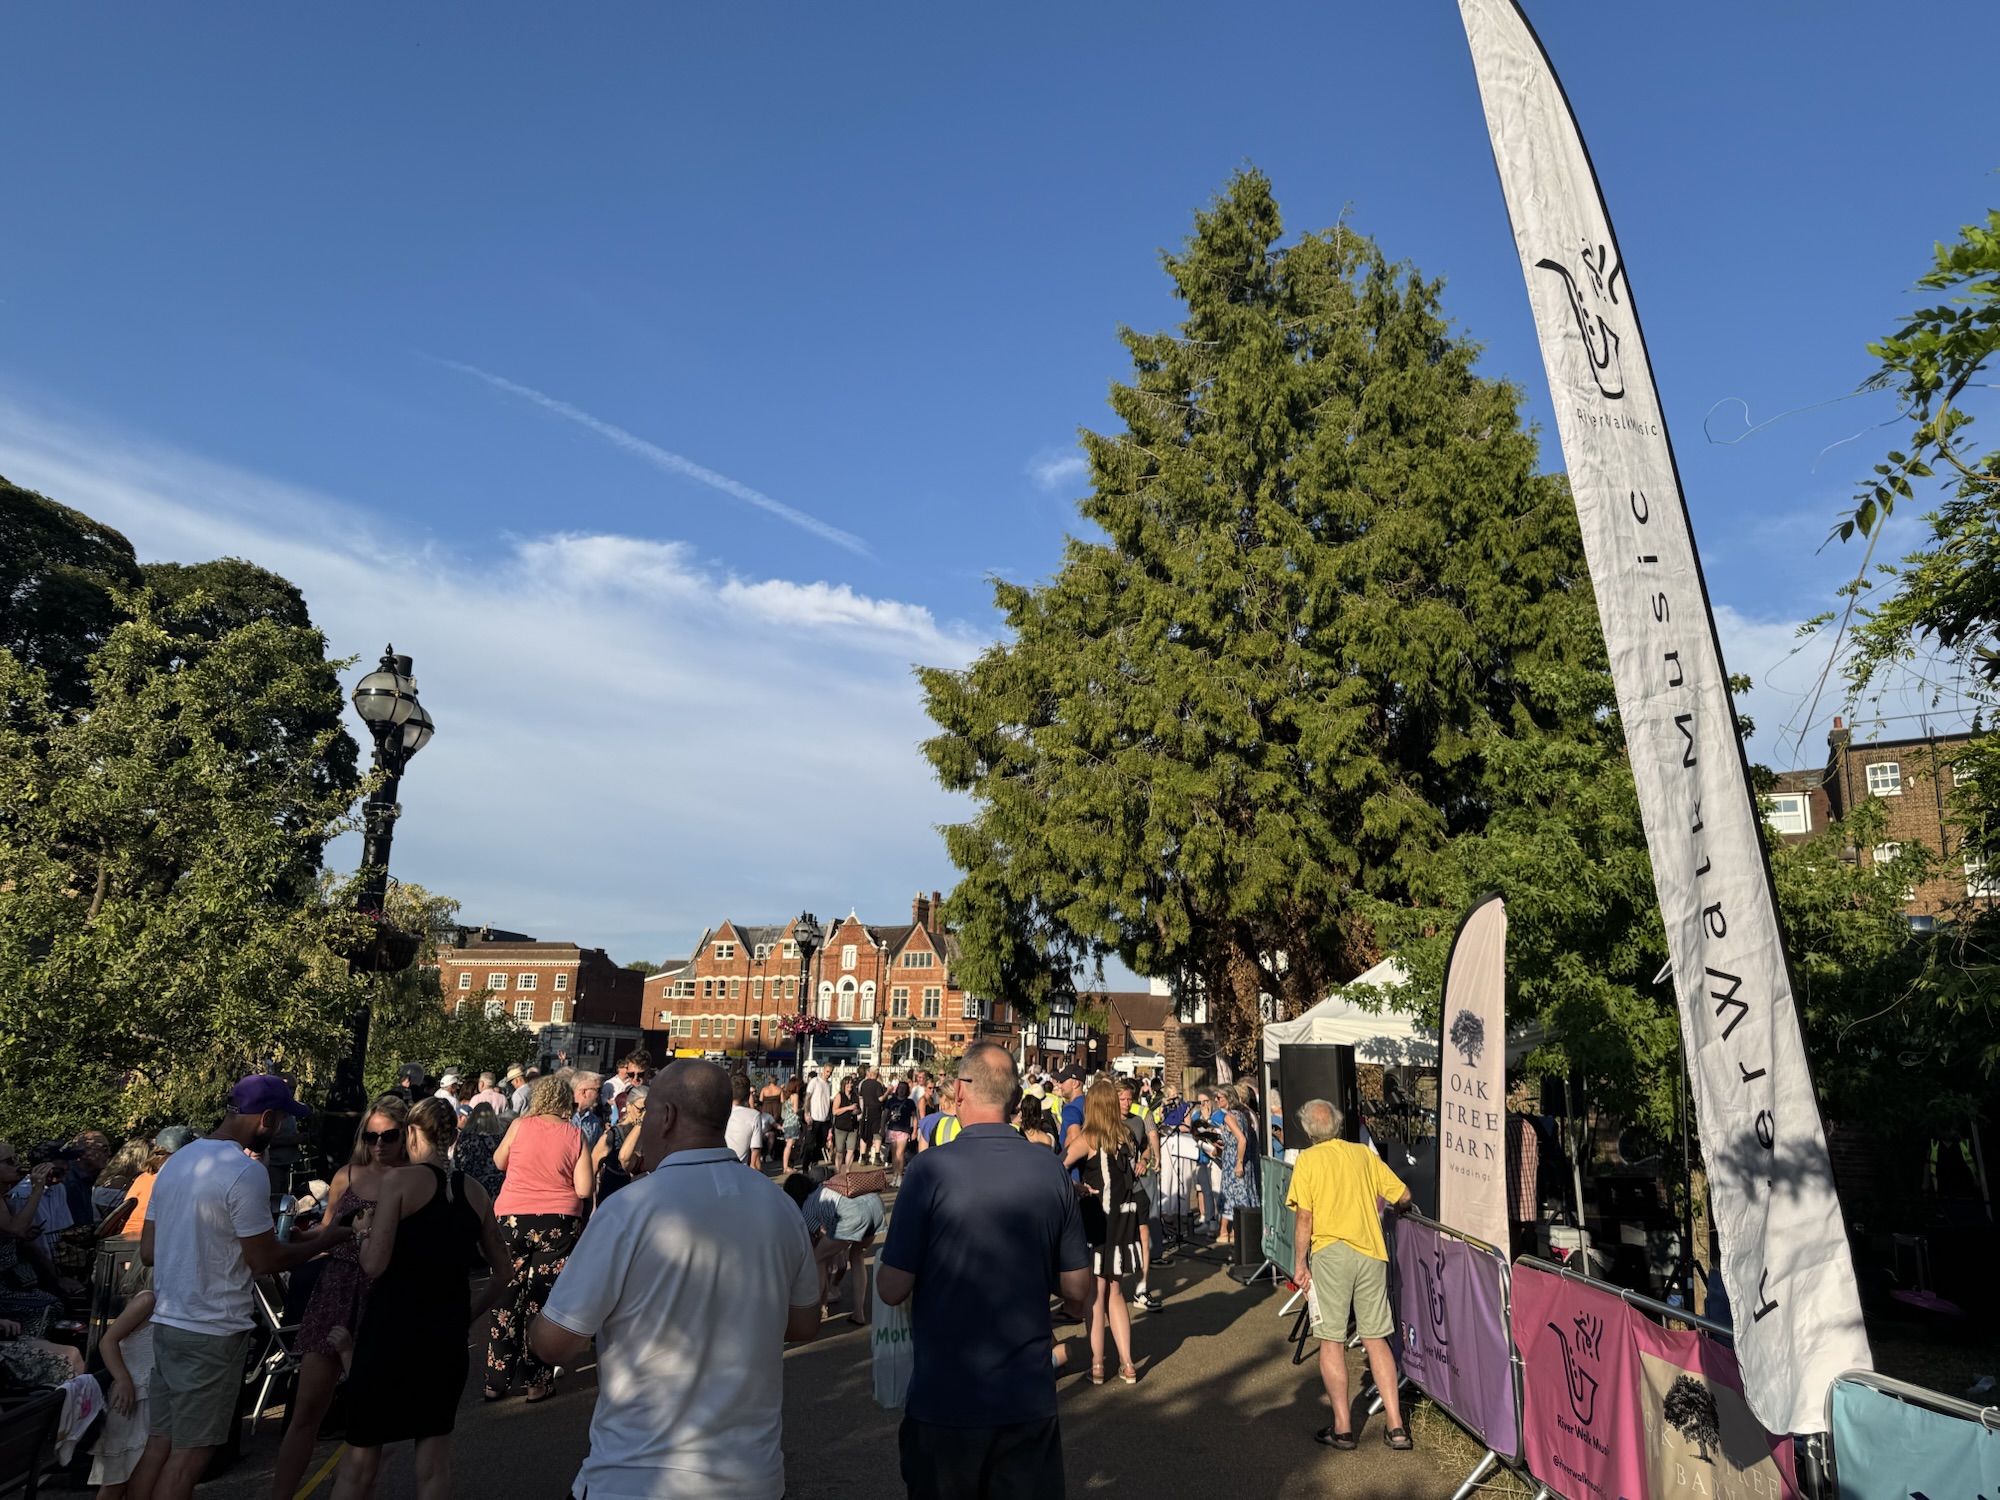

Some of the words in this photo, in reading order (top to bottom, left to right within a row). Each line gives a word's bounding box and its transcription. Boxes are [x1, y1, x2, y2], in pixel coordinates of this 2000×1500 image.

[1450, 1073, 1489, 1101] OAK
[1445, 1101, 1498, 1132] TREE
[1445, 1131, 1496, 1161] BARN
[1557, 1414, 1575, 1435] River
[1574, 1424, 1592, 1447] Walk
